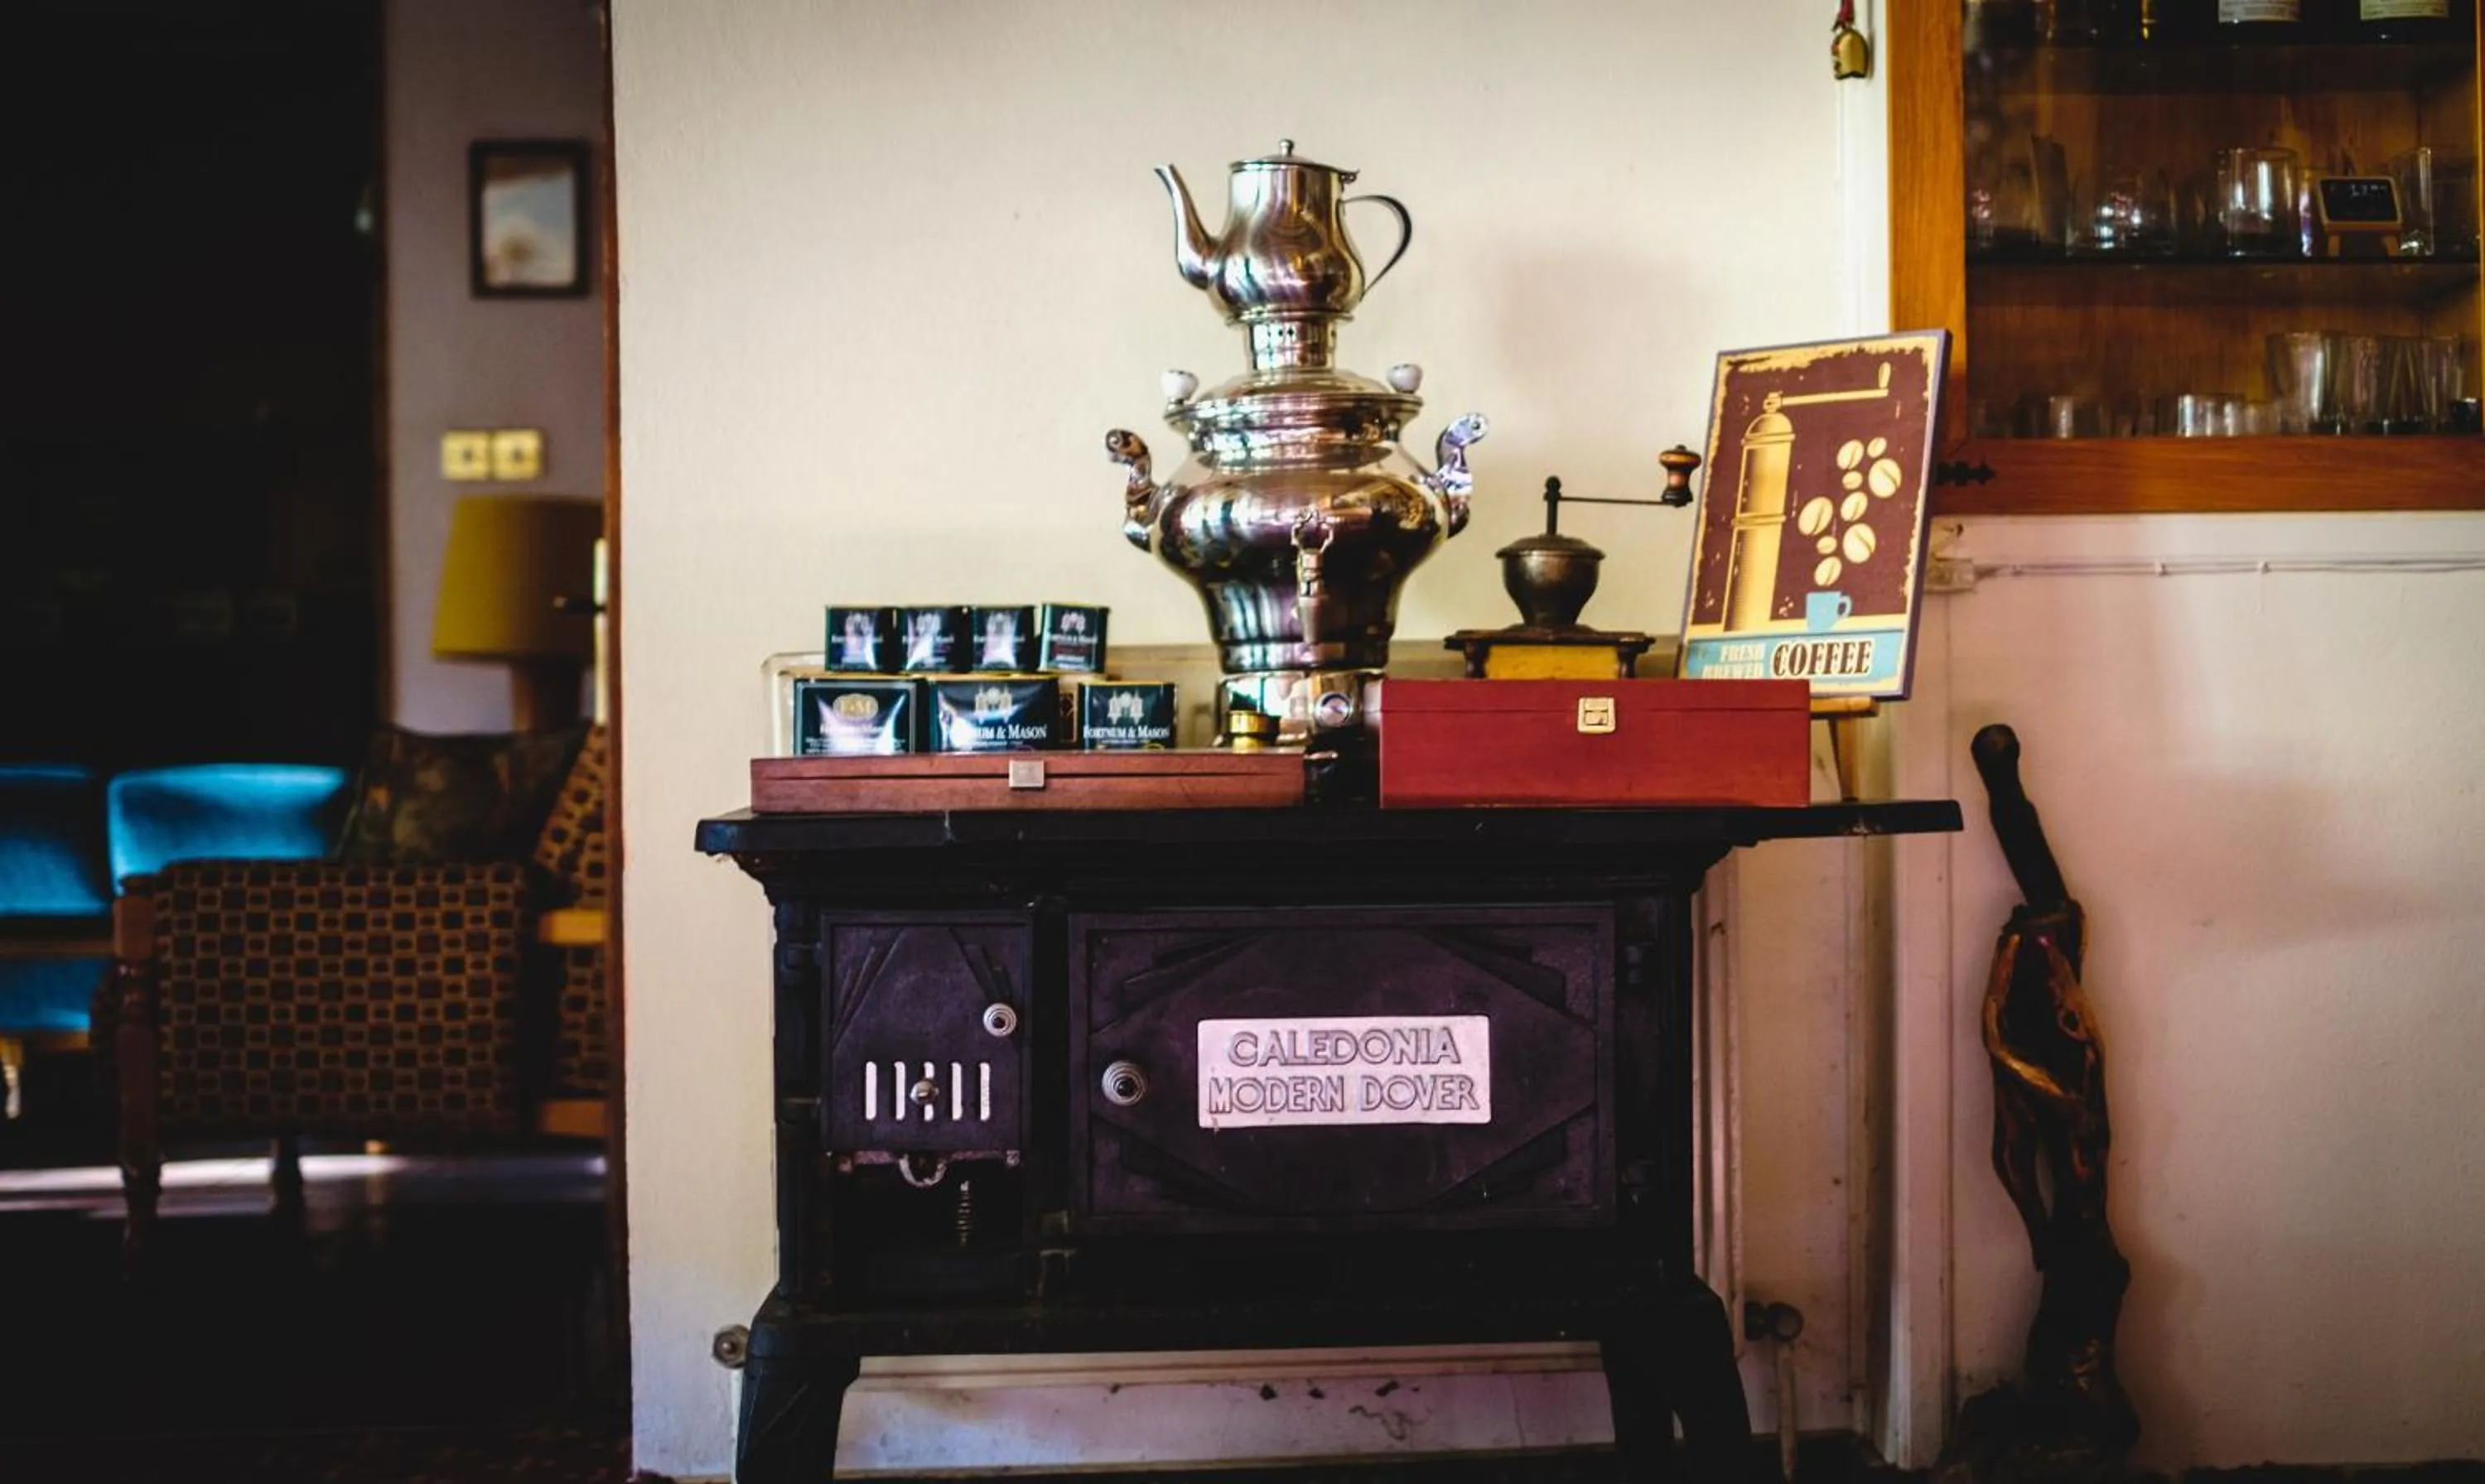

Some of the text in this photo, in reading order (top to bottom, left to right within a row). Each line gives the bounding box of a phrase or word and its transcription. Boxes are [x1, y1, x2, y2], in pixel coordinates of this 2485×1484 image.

[1773, 641, 1872, 677] COFFEE
[1008, 724, 1048, 739] MASON
[1228, 1027, 1460, 1067] CALEDONIA
[1209, 1075, 1479, 1114] MODERN DOVER
